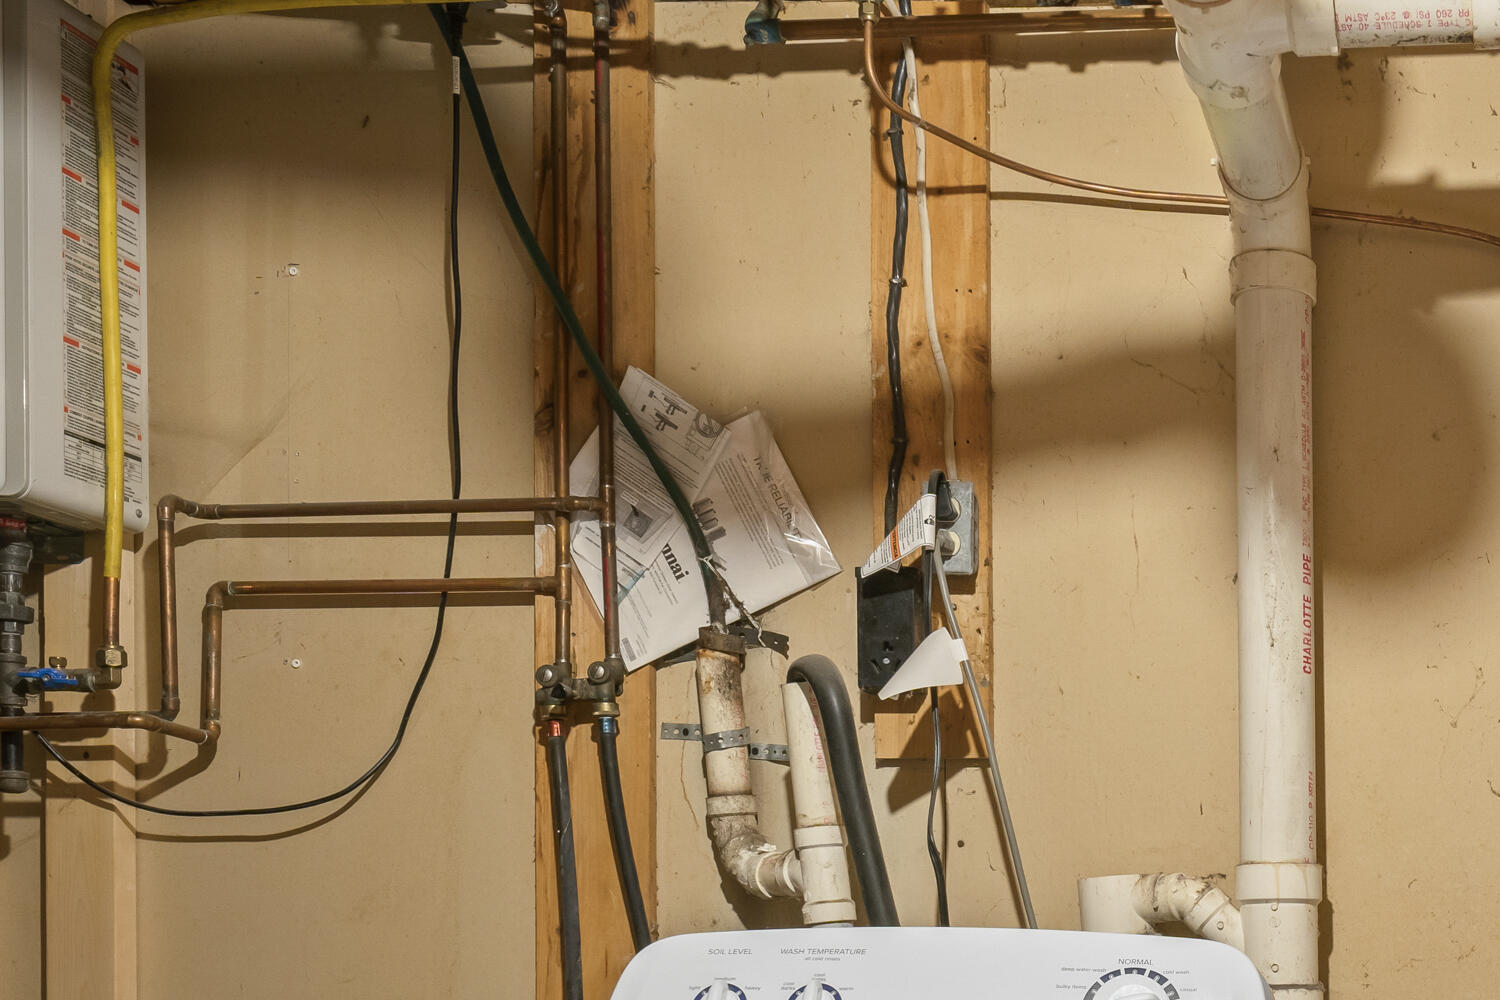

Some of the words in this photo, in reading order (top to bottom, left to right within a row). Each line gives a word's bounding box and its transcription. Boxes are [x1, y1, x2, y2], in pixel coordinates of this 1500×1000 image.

[1345, 12, 1369, 22] ASTM
[1436, 9, 1453, 18] 260
[1358, 23, 1370, 31] 40
[1375, 20, 1423, 30] SCHEDULE
[1302, 554, 1312, 585] PIPE
[1302, 595, 1312, 675] CHARLOTTE
[806, 948, 868, 956] TEMPERATURE
[1118, 958, 1153, 966] NORMAL
